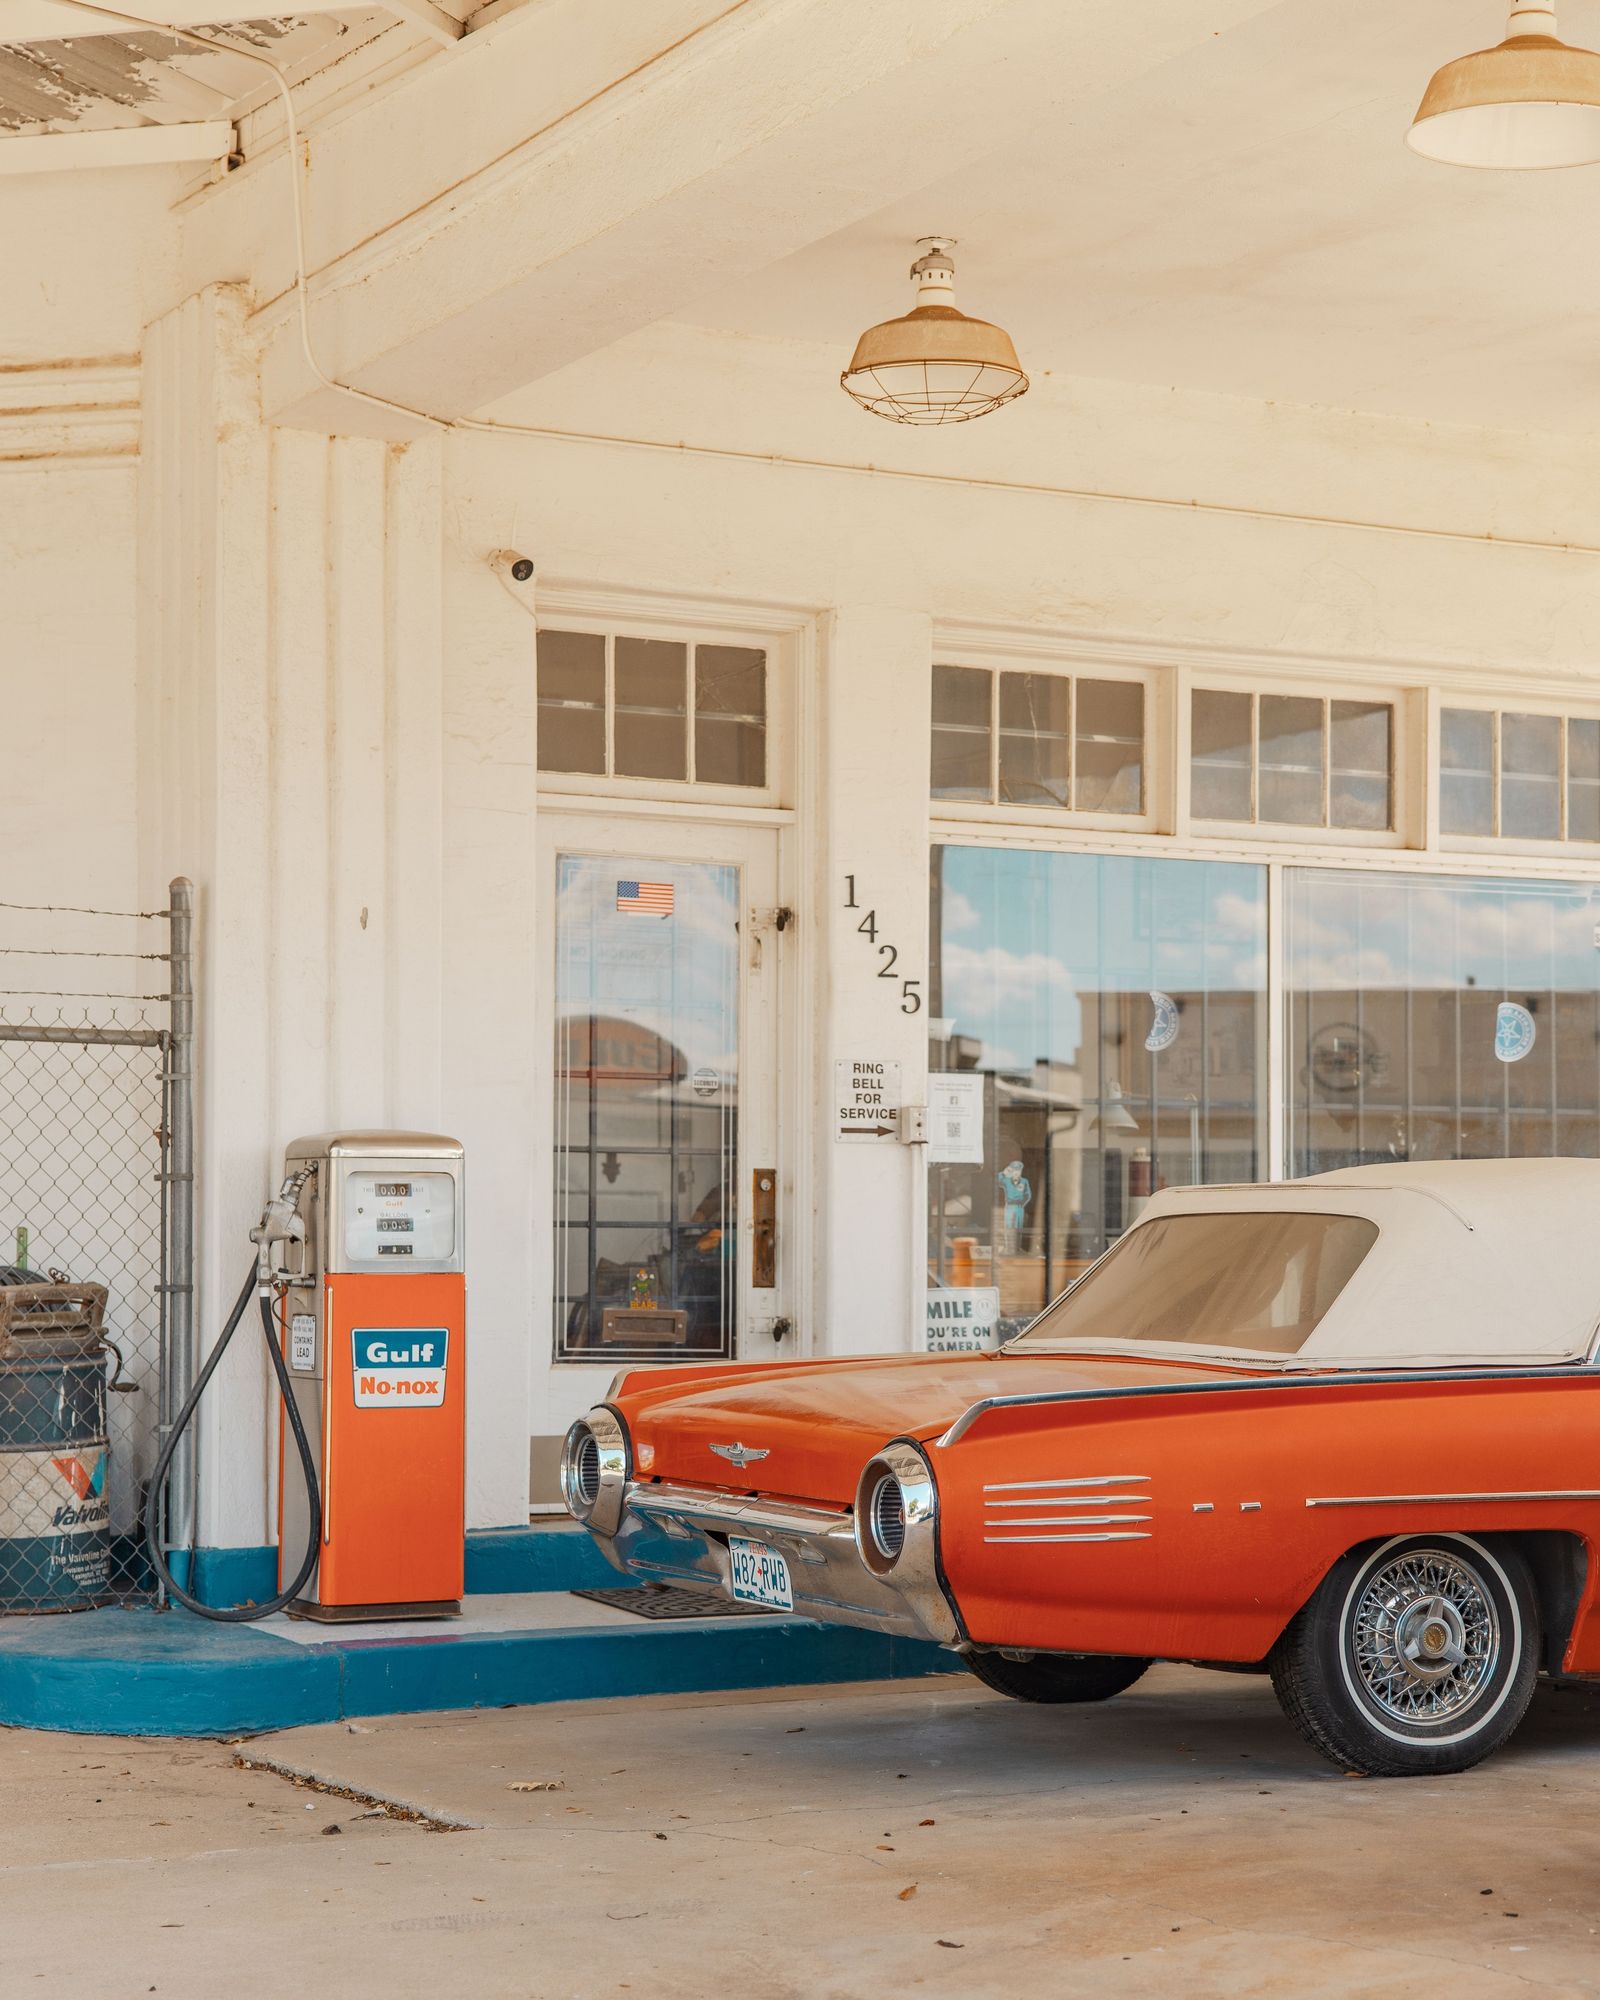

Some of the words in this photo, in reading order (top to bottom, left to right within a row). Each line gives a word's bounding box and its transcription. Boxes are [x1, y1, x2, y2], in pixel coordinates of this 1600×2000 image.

[842, 874, 921, 1014] 1425
[852, 1062, 885, 1075] RING
[852, 1078, 884, 1090] BELL
[855, 1093, 882, 1105] FOR
[839, 1108, 897, 1120] SERVICE
[926, 1300, 973, 1319] MILE
[927, 1326, 967, 1339] OU'RE
[972, 1326, 991, 1337] ON
[296, 1347, 310, 1358] LEAD
[366, 1342, 434, 1363] Gulf
[927, 1341, 982, 1352] CAMERA
[360, 1376, 439, 1395] No-nox
[748, 1542, 768, 1556] TEXAS
[50, 1555, 66, 1565] The
[68, 1550, 100, 1563] Valvoline
[761, 1557, 786, 1593] RWB
